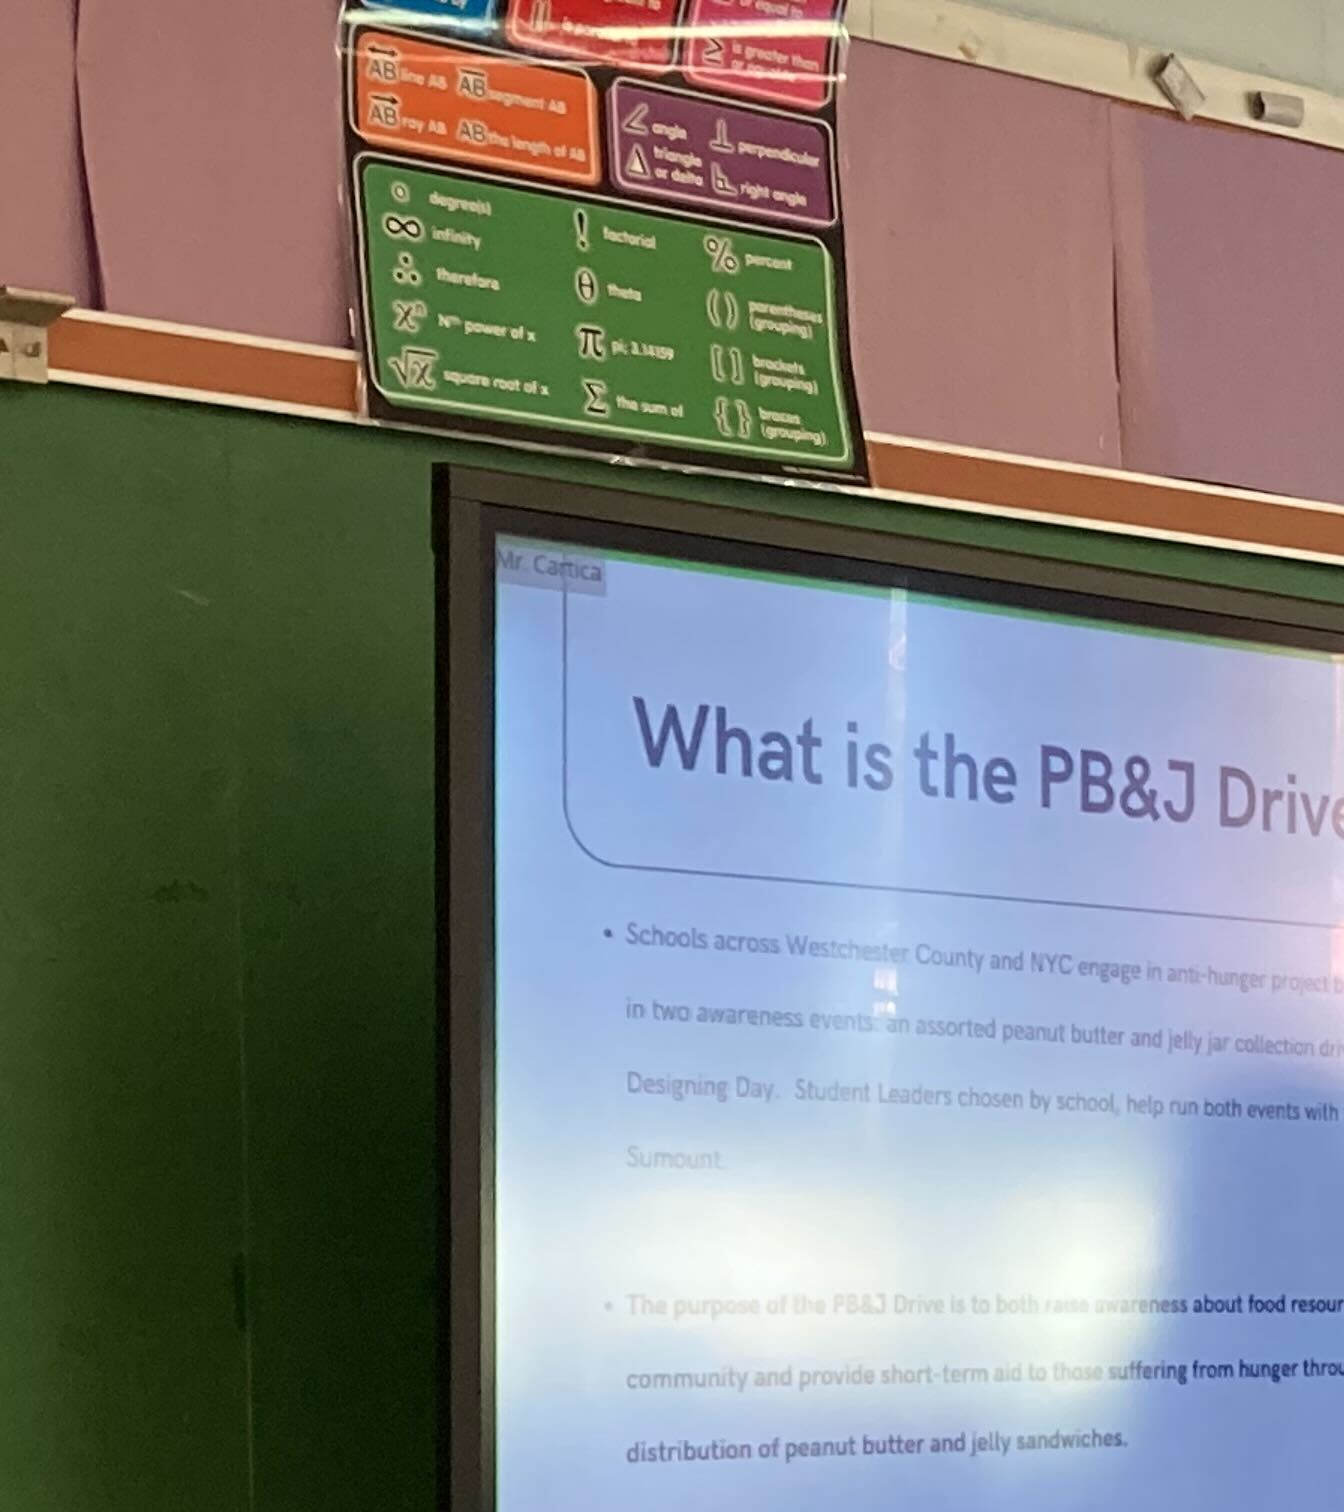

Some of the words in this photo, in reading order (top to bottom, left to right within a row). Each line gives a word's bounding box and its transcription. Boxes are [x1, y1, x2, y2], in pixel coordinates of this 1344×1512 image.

[533, 553, 603, 582] Cartica
[632, 696, 823, 785] What
[847, 720, 894, 792] is
[914, 732, 1017, 804] the
[1040, 744, 1195, 823] PB&J
[626, 921, 708, 951] Schools
[714, 933, 780, 955] across
[786, 934, 910, 963] Westchester
[914, 943, 984, 975] County
[990, 949, 1024, 972] and
[1030, 952, 1073, 976] NYC
[1077, 960, 1142, 984] engage
[1146, 960, 1163, 983] in
[1166, 964, 1267, 994] anti-hunger
[1271, 973, 1330, 998] project
[626, 998, 645, 1020] in
[652, 1000, 690, 1023] two
[695, 1006, 804, 1029] awareness
[886, 1016, 910, 1034] an
[914, 1015, 996, 1041] assorted
[1002, 1024, 1067, 1048] peanut
[1070, 1024, 1125, 1047] butter
[1130, 1027, 1163, 1049] and
[1166, 1029, 1204, 1056] jelly
[1206, 1033, 1230, 1057] jar
[1234, 1034, 1315, 1058] collection
[626, 1070, 729, 1101] Designing
[793, 1078, 871, 1103] Student
[878, 1082, 952, 1107] Leaders
[956, 1087, 1024, 1111] chosen
[1029, 1089, 1051, 1115] by
[1056, 1091, 1121, 1117] school,
[1126, 1093, 1165, 1118] help
[1169, 1100, 1199, 1117] run
[1203, 1098, 1242, 1119] both
[1246, 1102, 1301, 1122] events
[1304, 1100, 1341, 1123] with
[1193, 1293, 1244, 1314] about
[1248, 1293, 1286, 1314] food
[626, 1364, 748, 1393] community
[753, 1365, 792, 1387] and
[798, 1364, 876, 1392] provide
[880, 1362, 989, 1386] short-term
[1108, 1359, 1188, 1386] suffering
[1192, 1359, 1235, 1380] from
[1238, 1358, 1299, 1384] hunger
[626, 1438, 752, 1464] distribution
[758, 1437, 780, 1459] of
[785, 1436, 856, 1464] peanut
[862, 1434, 925, 1456] butter
[929, 1432, 966, 1454] and
[970, 1430, 1011, 1458] jelly
[1016, 1427, 1129, 1451] sandwiches.
